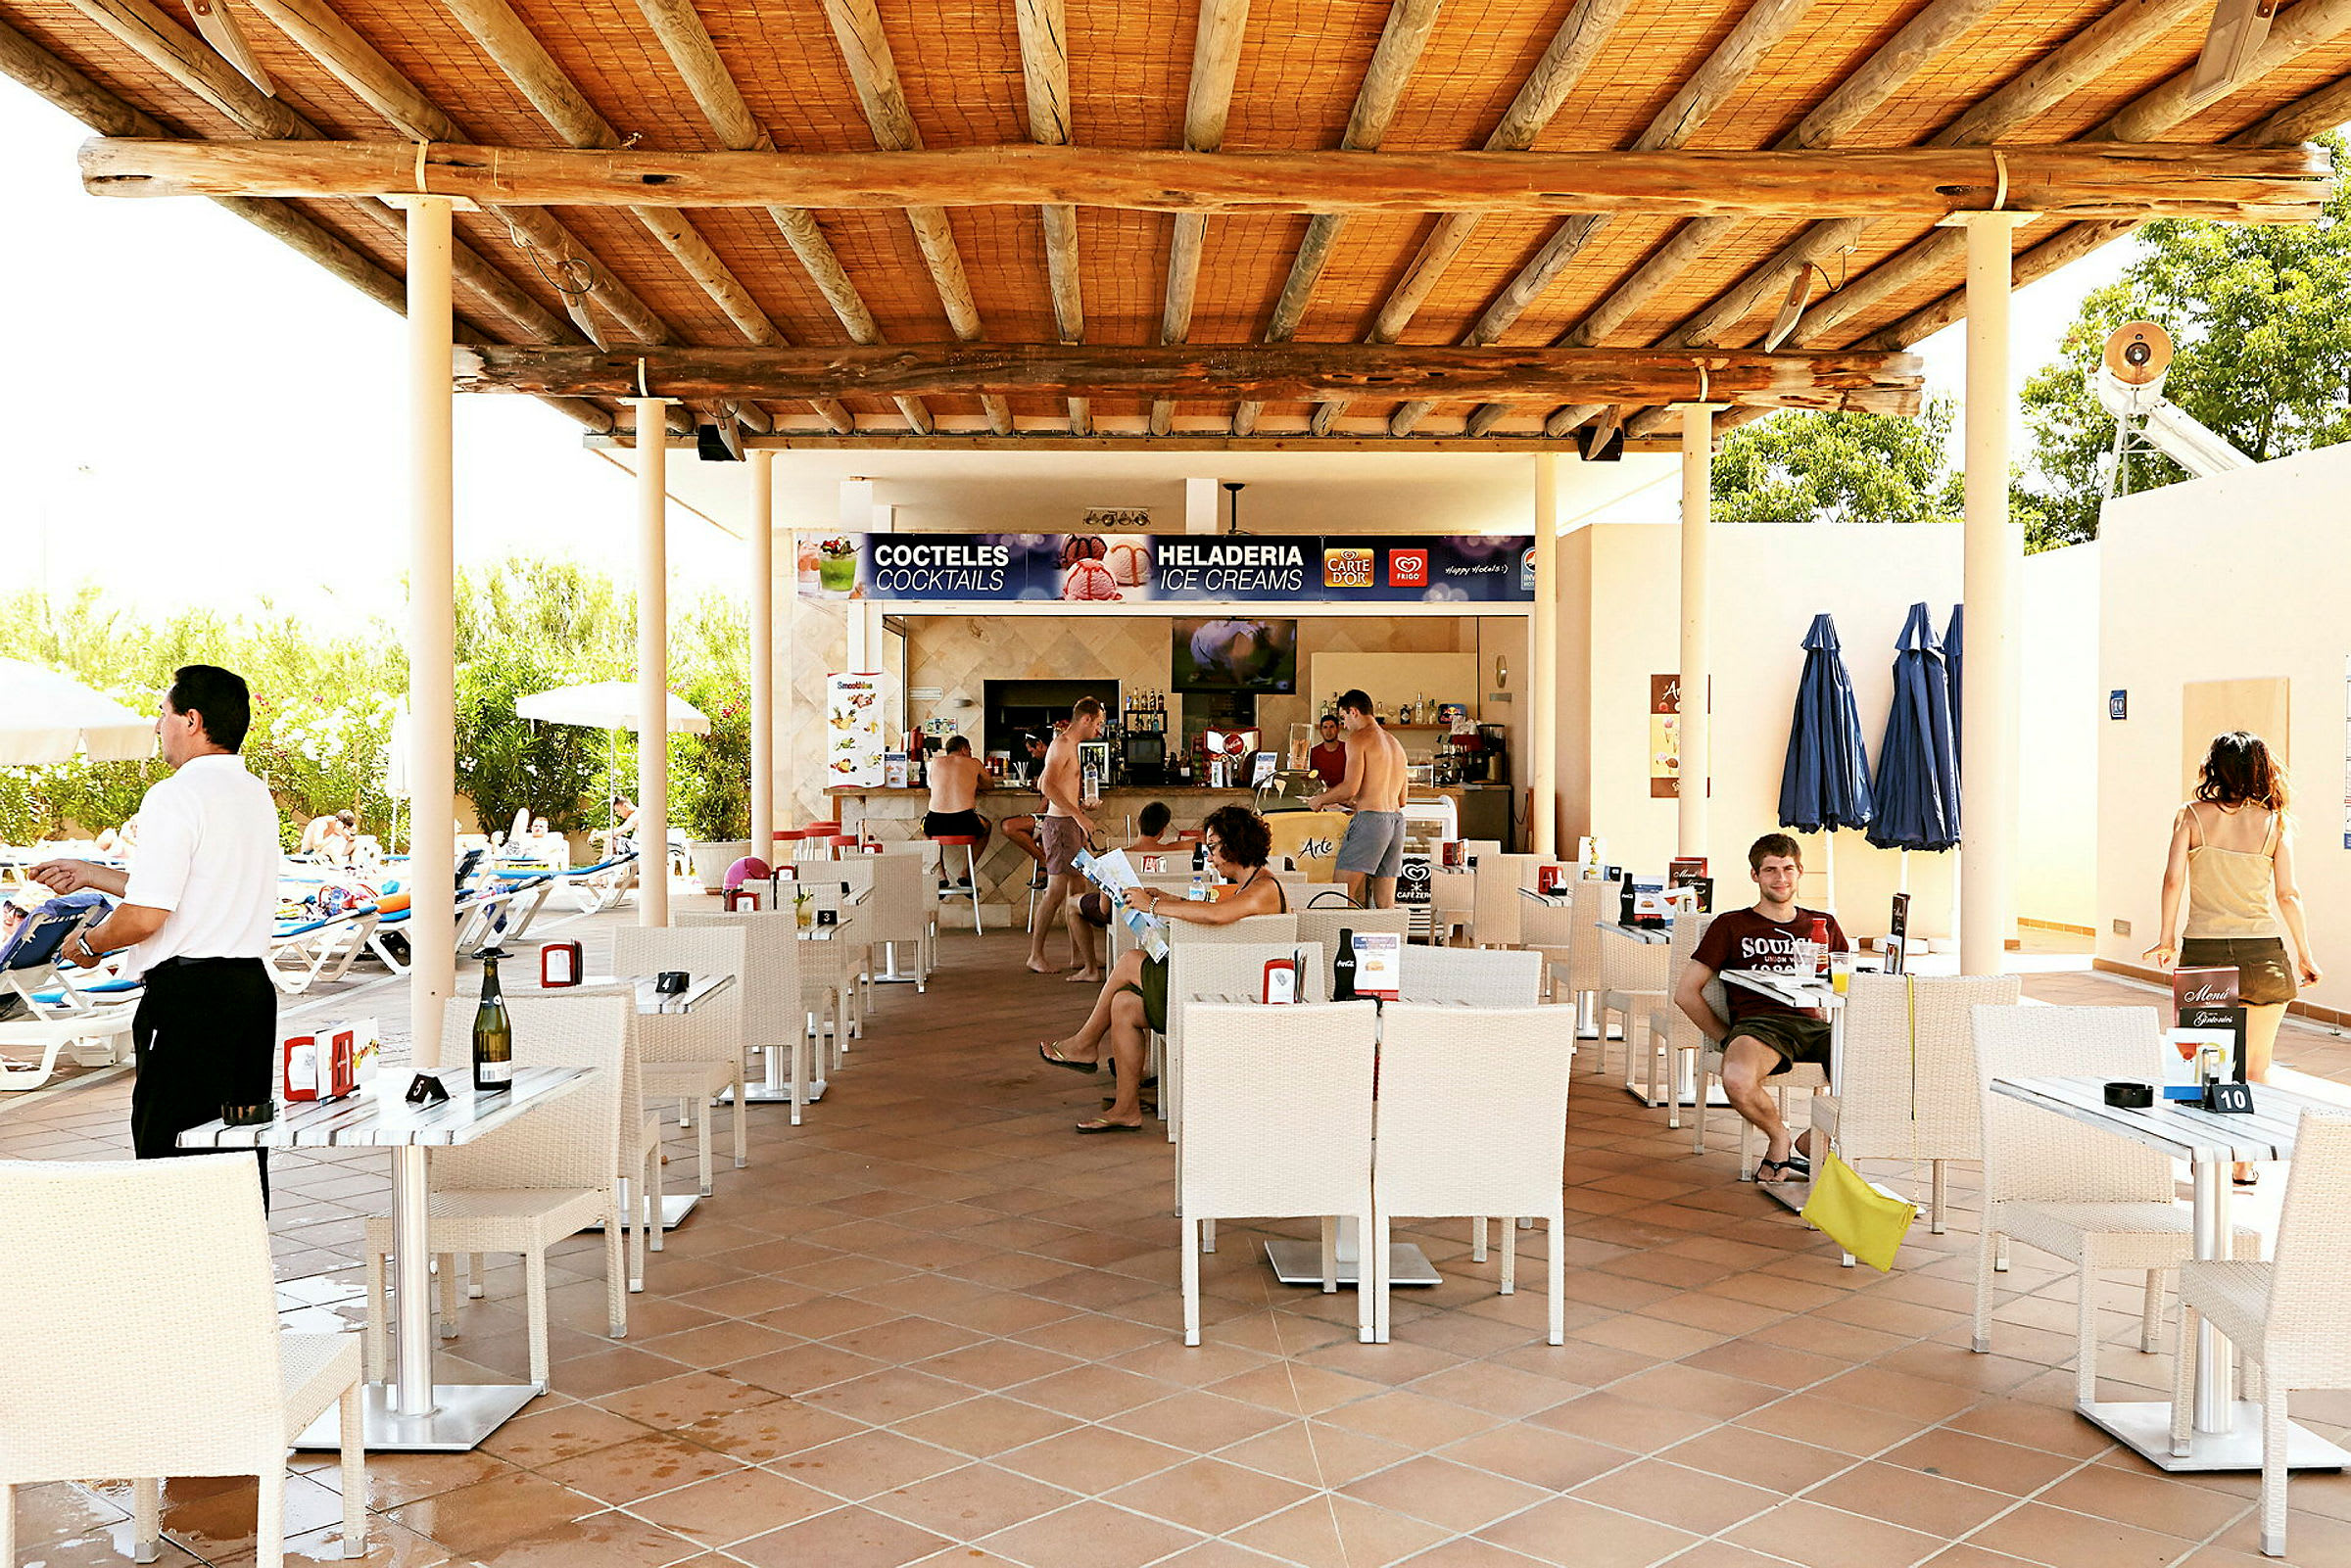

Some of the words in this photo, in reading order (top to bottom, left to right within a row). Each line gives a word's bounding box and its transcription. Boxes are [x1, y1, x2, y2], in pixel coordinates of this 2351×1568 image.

[875, 545, 1009, 567] COCTELES
[1158, 546, 1304, 566] HELADERIA
[1327, 558, 1369, 574] CARTE
[876, 569, 1004, 591] COCKTAILS
[1161, 569, 1199, 591] ICE
[1205, 569, 1303, 591] CREAMS
[1332, 572, 1367, 586] D'OR
[1297, 835, 1332, 860] Arte
[823, 912, 831, 923] 3
[661, 976, 671, 990] 4
[2183, 983, 2231, 1002] Menú
[412, 1079, 425, 1097] 5
[2221, 1089, 2246, 1110] 10
